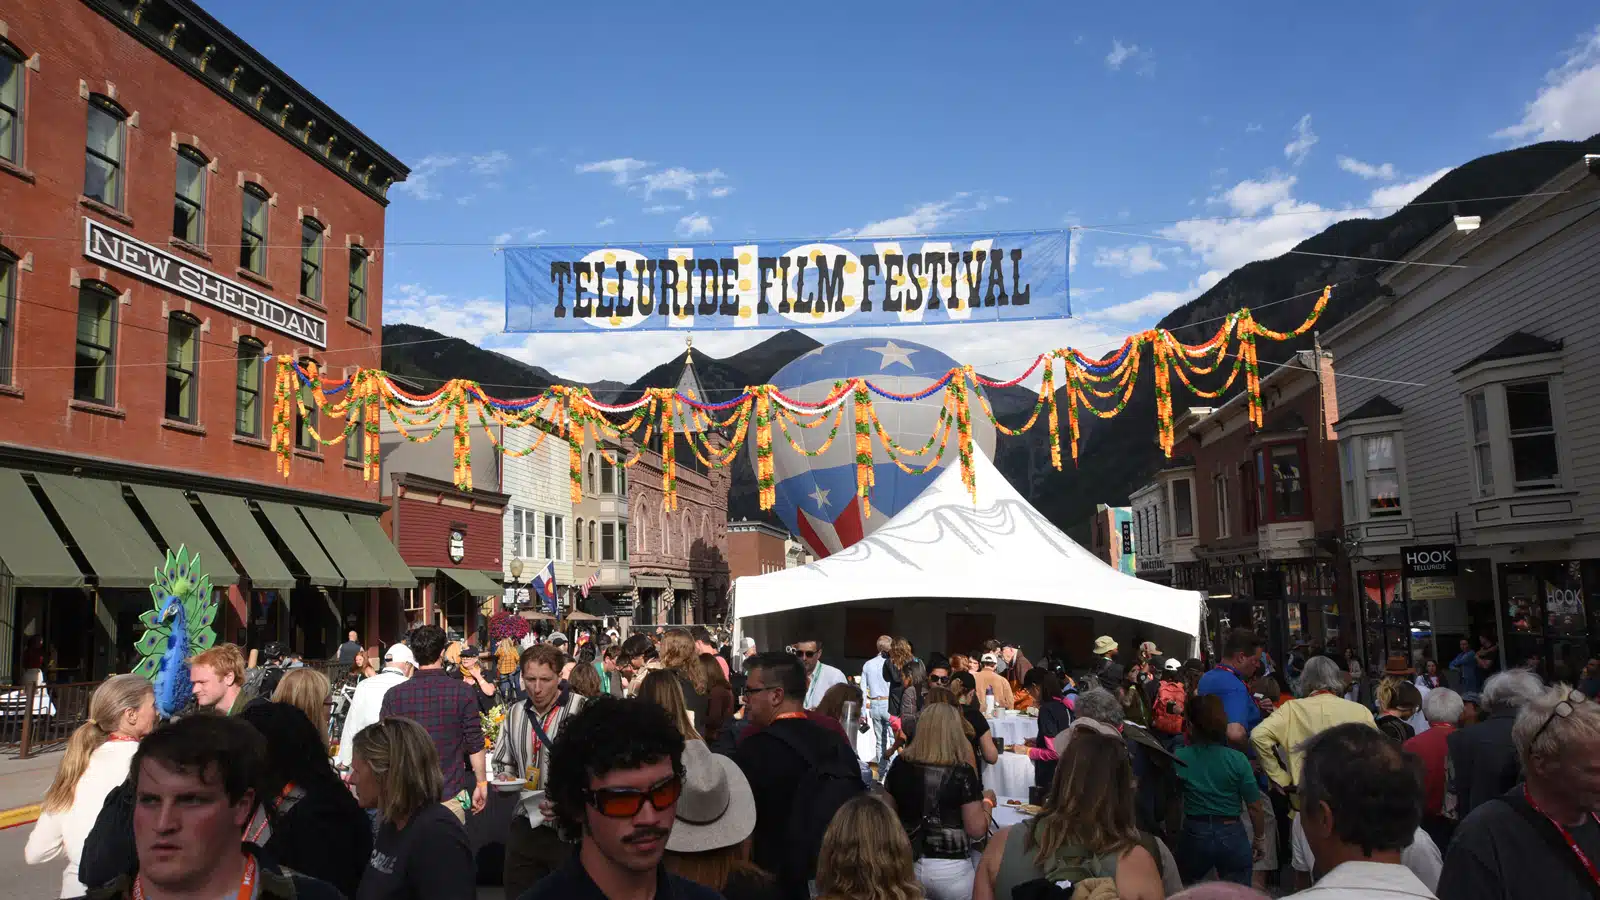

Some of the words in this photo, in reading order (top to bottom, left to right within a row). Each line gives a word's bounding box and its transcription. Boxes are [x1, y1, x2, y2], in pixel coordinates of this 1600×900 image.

[93, 228, 171, 279] NEW
[550, 258, 739, 319] TELLURIDE
[757, 255, 847, 316] FILM
[859, 248, 1031, 313] FESTIVAL
[1406, 550, 1453, 565] HOOK
[1413, 563, 1447, 571] TELLURIDE
[1546, 589, 1583, 605] HOOK
